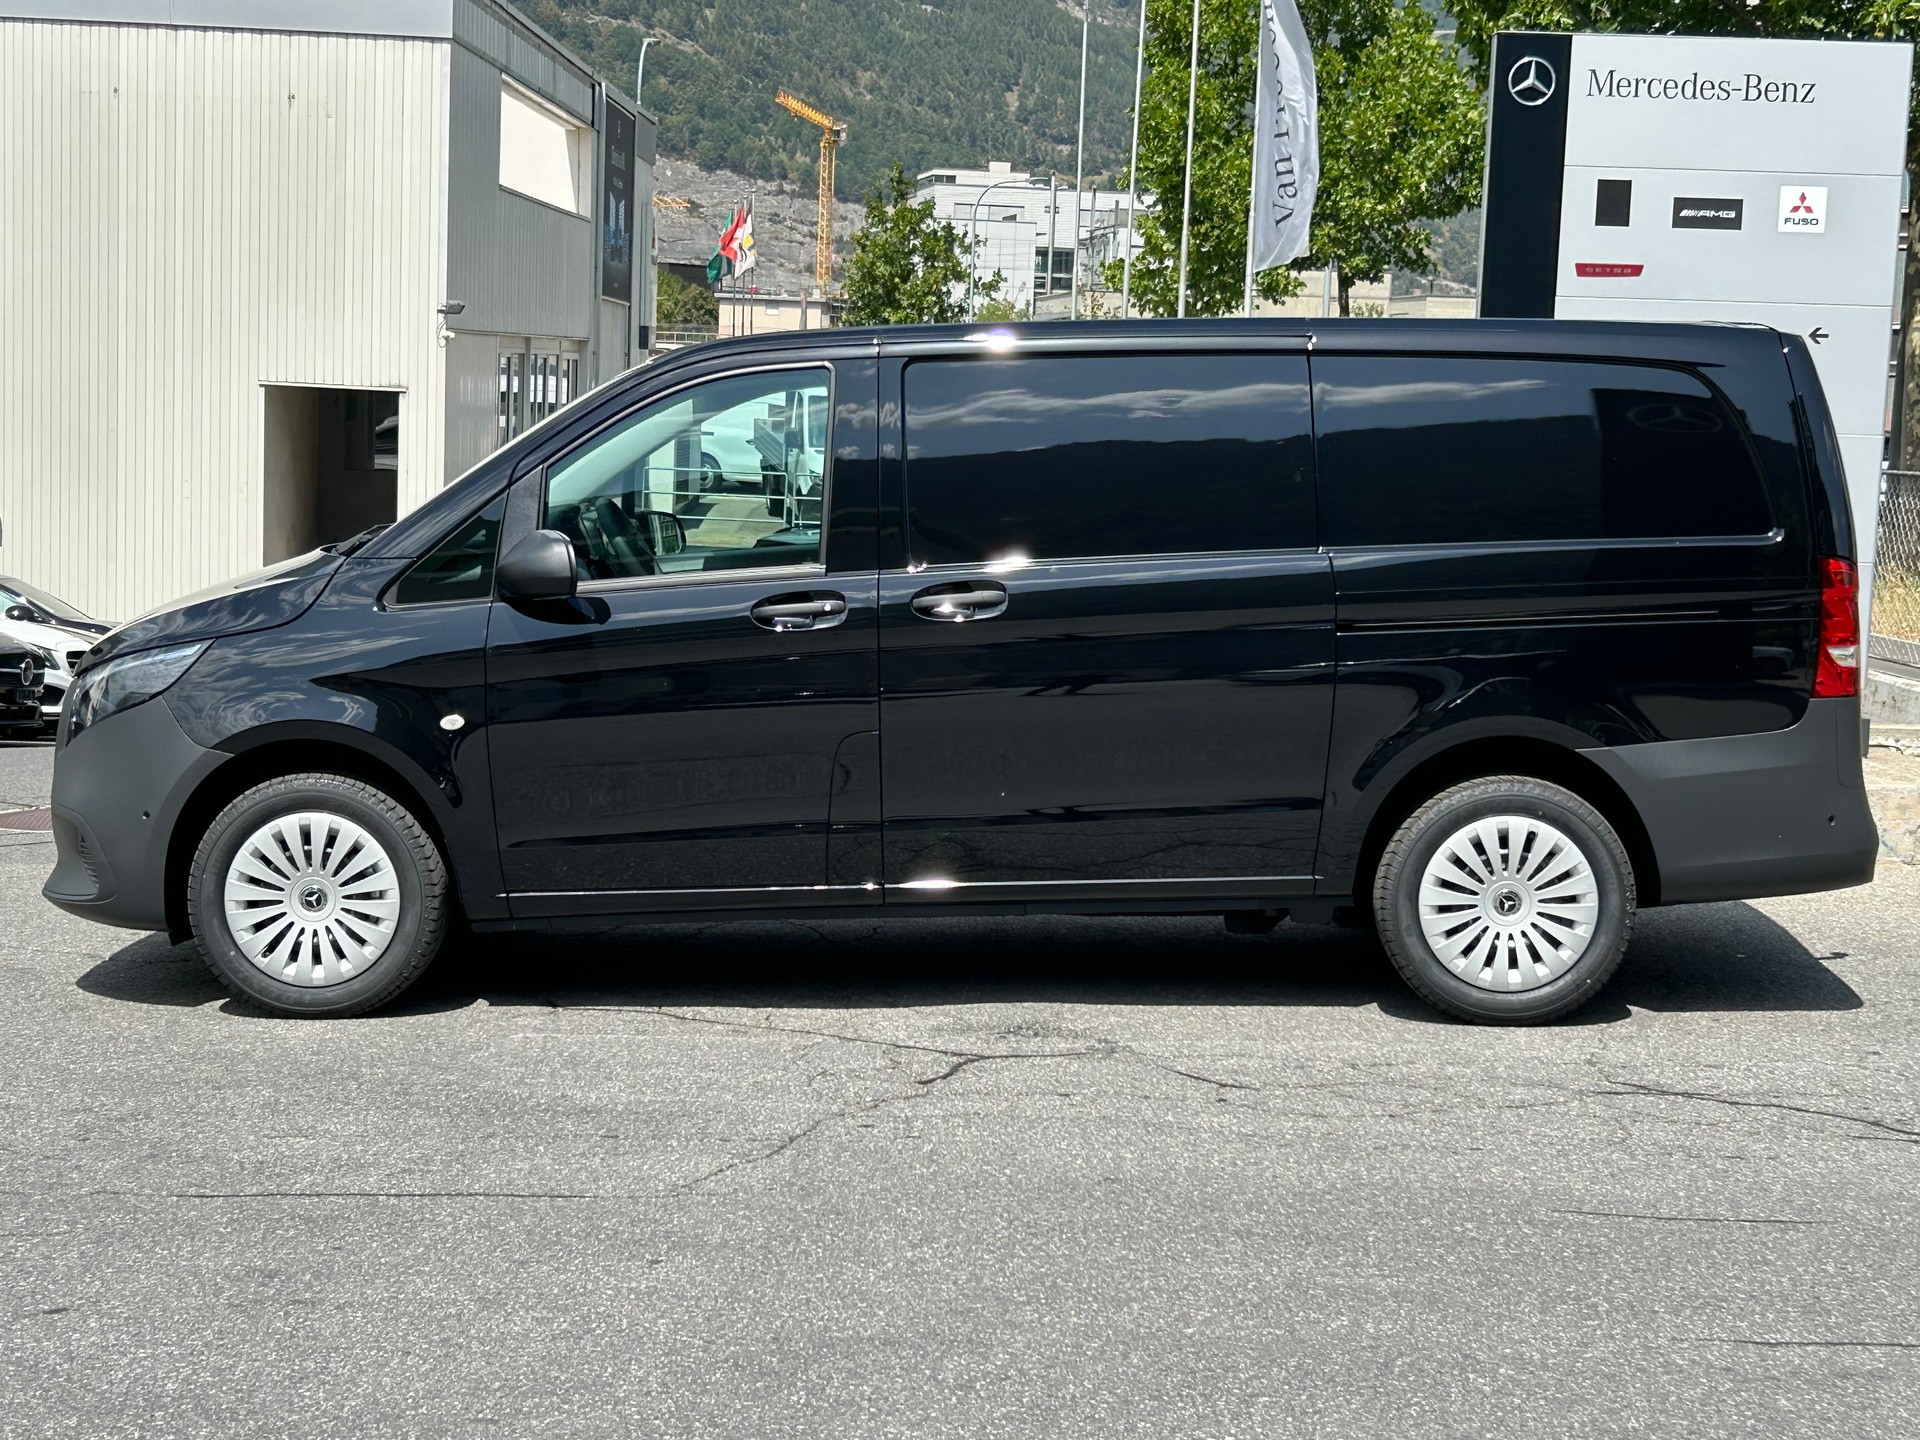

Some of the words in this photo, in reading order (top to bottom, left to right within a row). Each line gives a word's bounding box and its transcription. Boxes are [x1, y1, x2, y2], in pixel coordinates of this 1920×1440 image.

[1586, 68, 1816, 103] Mercedes-Benz
[1272, 153, 1298, 227] Van
[1697, 209, 1736, 219] AMG
[1784, 217, 1819, 226] FUSO
